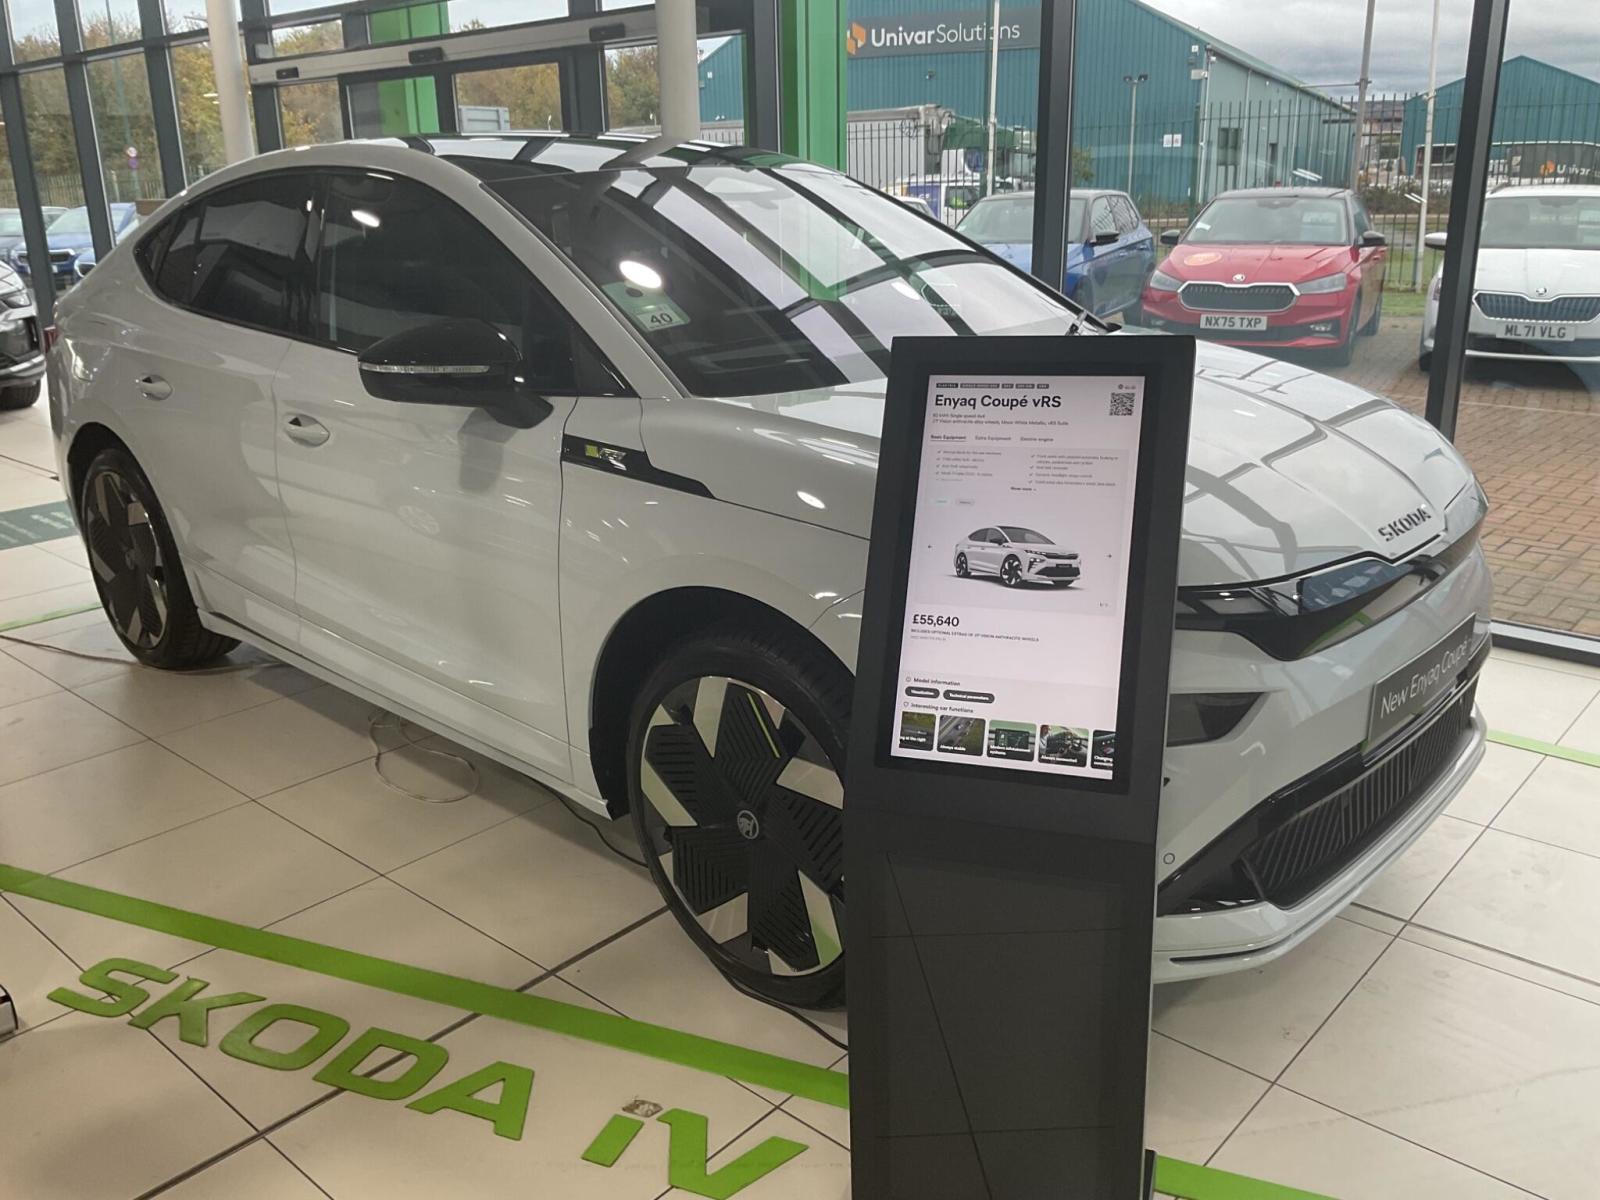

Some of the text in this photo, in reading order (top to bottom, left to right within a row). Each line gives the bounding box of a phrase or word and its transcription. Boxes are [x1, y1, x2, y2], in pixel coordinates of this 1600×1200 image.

[650, 312, 673, 324] 40
[1204, 315, 1262, 329] NX75 TXP
[1540, 326, 1566, 339] VLG
[934, 394, 1062, 411] Enyaq Coupé vRS
[912, 613, 960, 627] £55,640
[1380, 686, 1408, 719] New
[1409, 663, 1440, 697] Enyaq
[911, 702, 938, 711] Interesting
[47, 957, 535, 1141] SKODA
